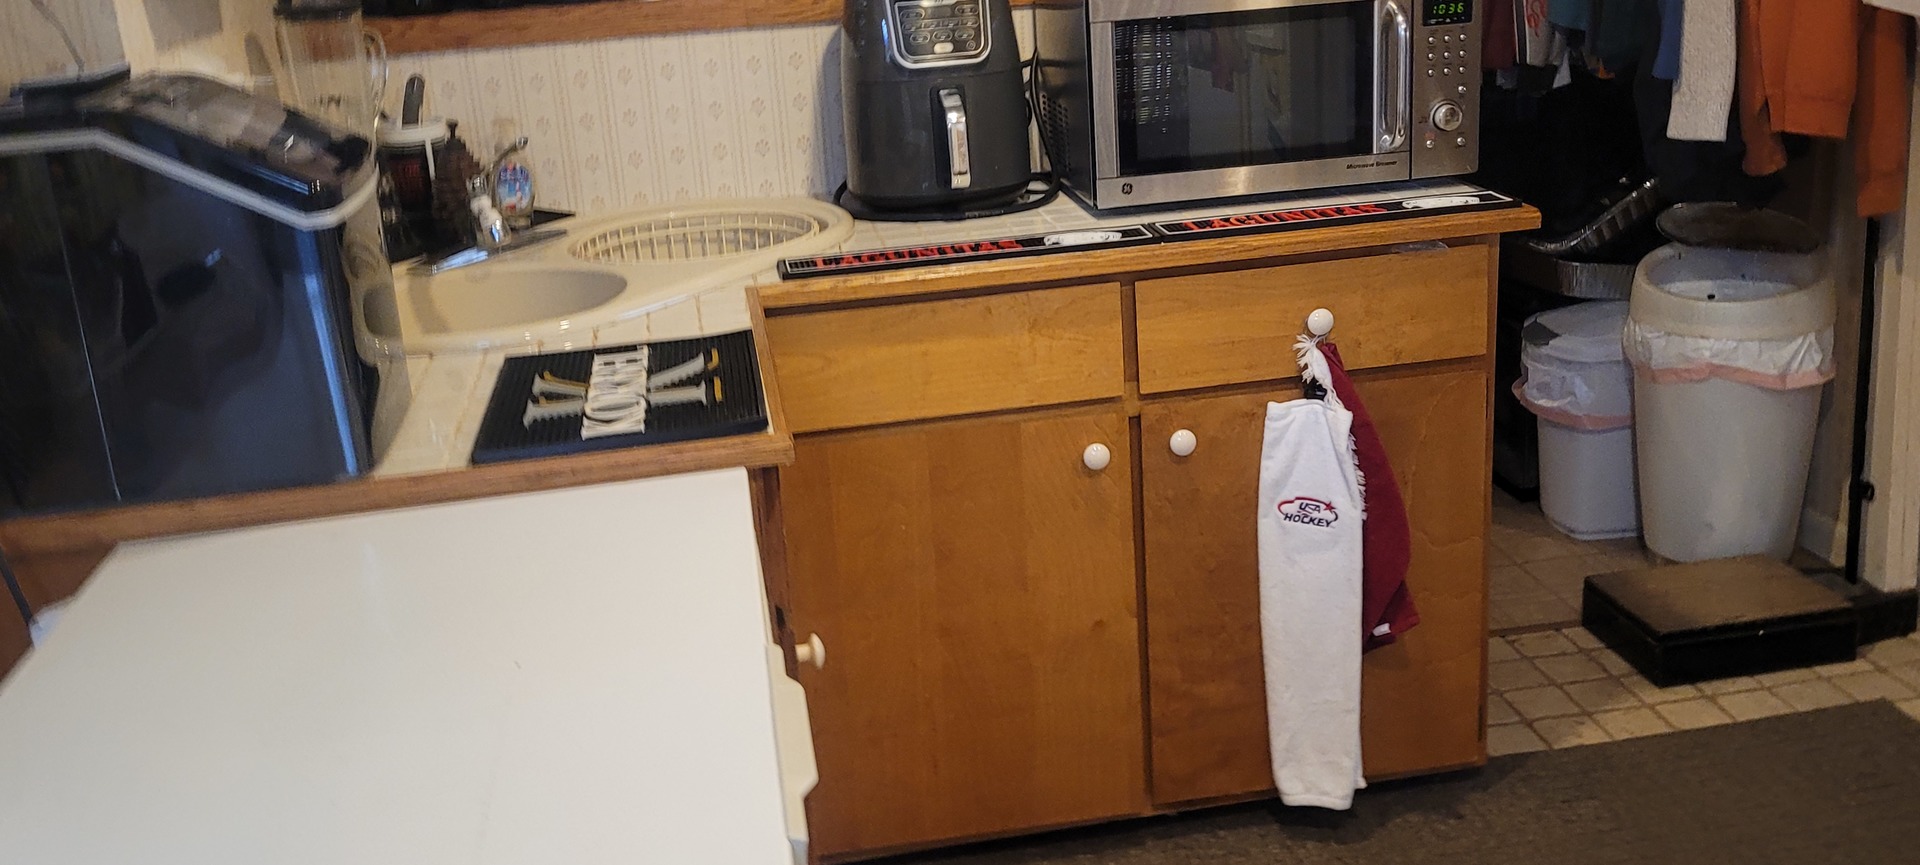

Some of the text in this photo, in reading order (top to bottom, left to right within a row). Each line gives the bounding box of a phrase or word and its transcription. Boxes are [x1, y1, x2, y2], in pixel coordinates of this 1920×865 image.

[1183, 203, 1388, 231] LAGUNITAS
[1299, 502, 1321, 513] USA
[1284, 513, 1332, 527] HOCKEY
